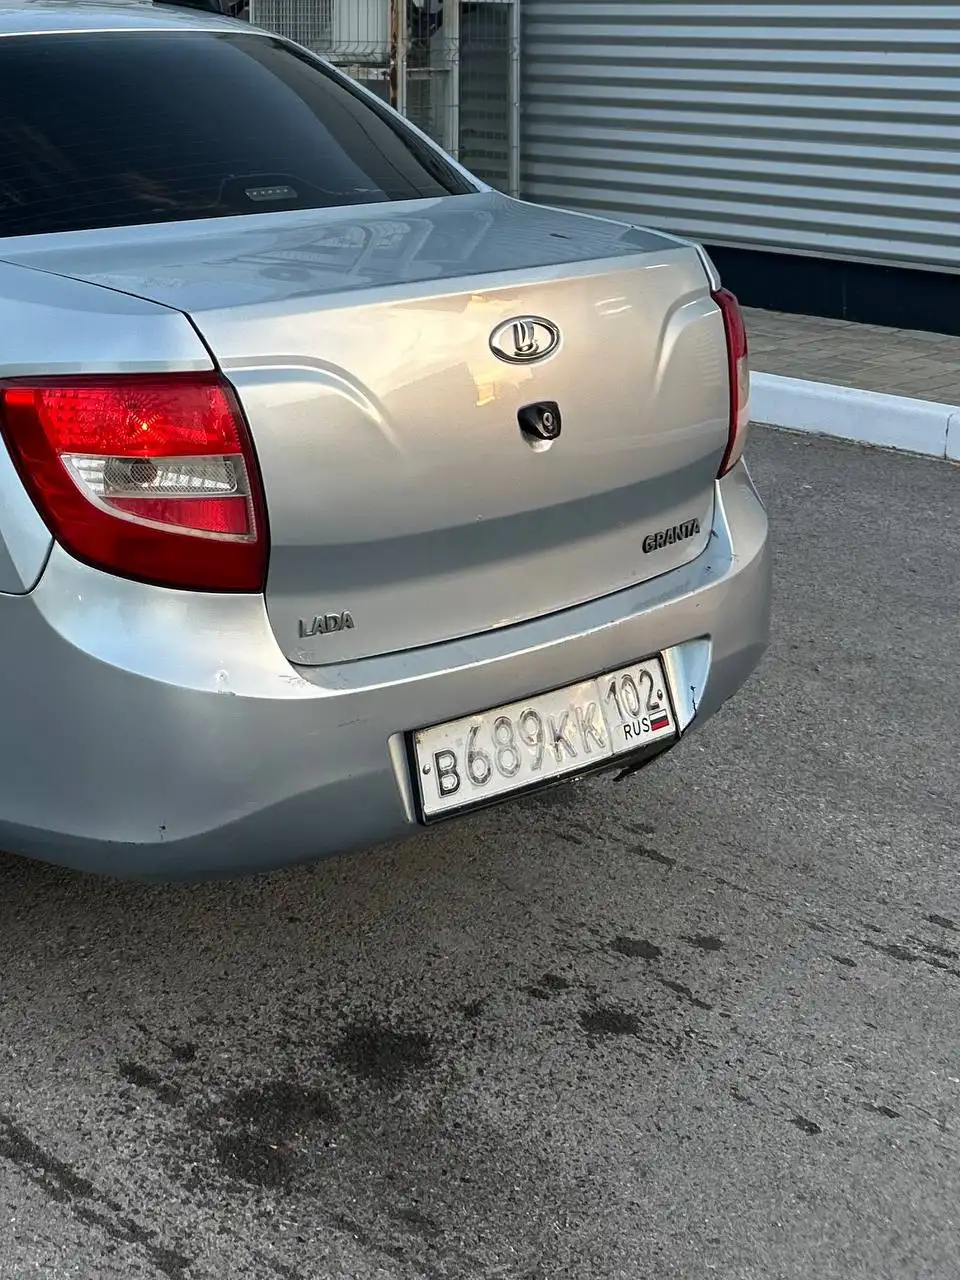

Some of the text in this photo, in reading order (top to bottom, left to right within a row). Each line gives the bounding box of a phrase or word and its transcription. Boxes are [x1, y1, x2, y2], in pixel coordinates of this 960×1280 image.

[642, 518, 700, 553] GRANTA
[299, 611, 355, 638] LADA
[605, 668, 660, 719] 102
[623, 717, 651, 740] RUS
